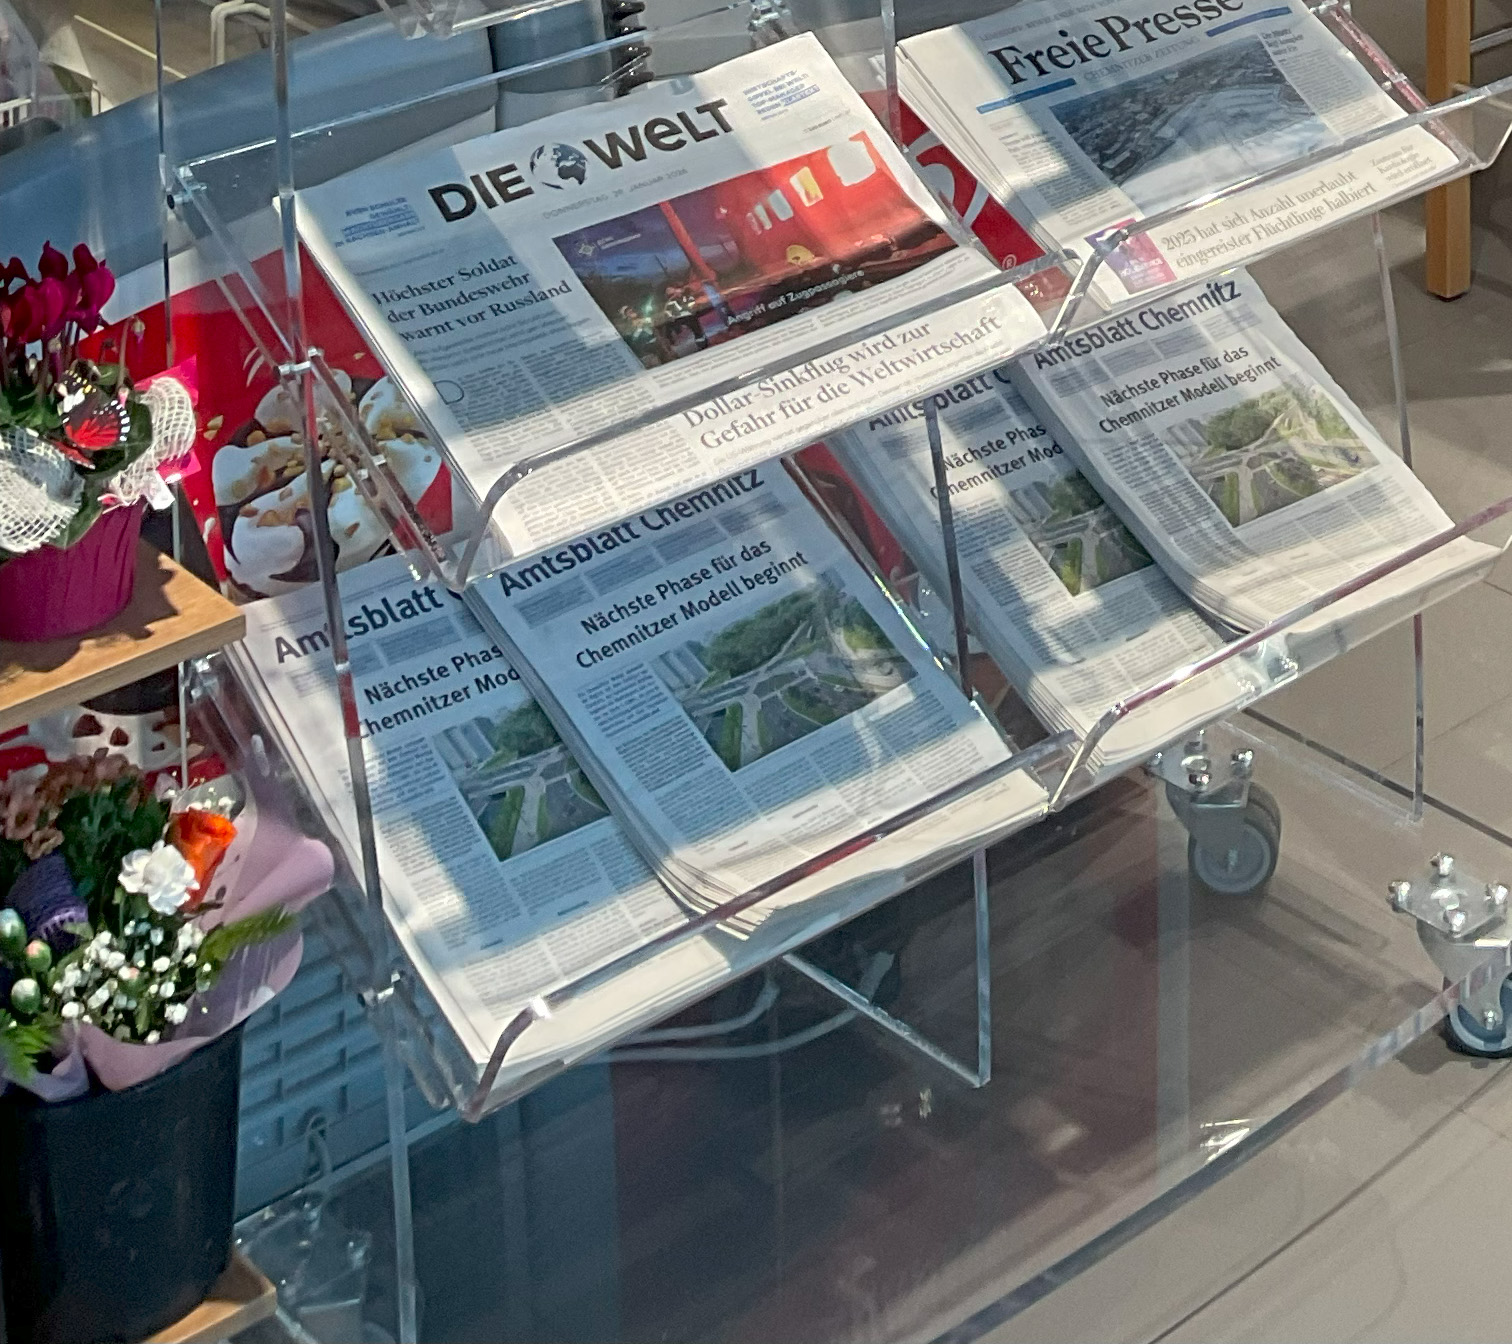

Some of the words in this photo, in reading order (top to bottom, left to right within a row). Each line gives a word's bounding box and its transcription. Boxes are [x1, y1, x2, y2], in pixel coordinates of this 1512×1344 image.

[428, 163, 535, 223] DIE
[1162, 231, 1197, 252] 2025
[1199, 222, 1219, 241] hat
[1222, 211, 1250, 233] sich
[1251, 193, 1295, 224] Anzahl
[1296, 170, 1359, 206] unerlaubt
[1176, 231, 1252, 269] eingereister
[1253, 203, 1326, 242] Flüchtlinge
[1327, 181, 1378, 213] halbiert
[371, 273, 455, 306] Höchster
[457, 254, 519, 282] Soldat
[387, 305, 419, 324] der
[421, 272, 530, 316] Bundeswehr
[399, 319, 457, 343] warnt
[457, 311, 491, 328] vor
[491, 280, 572, 317] Russland
[1034, 316, 1141, 369] Amtsblatt
[1139, 280, 1242, 331] Chemnitz
[680, 354, 845, 428] Dollar-Sinkflug
[848, 336, 897, 362] wird
[897, 321, 931, 346] zur
[700, 409, 776, 450] Gefahr
[778, 394, 815, 419] für
[816, 381, 850, 405] die
[848, 314, 1003, 389] Weltwirtschaft
[1100, 377, 1160, 408] Nächste
[1159, 360, 1201, 384] Phase
[1200, 352, 1222, 374] für
[1224, 345, 1249, 364] das
[1100, 394, 1181, 433] Chemnitzer
[1181, 376, 1228, 403] Modell
[1228, 356, 1281, 386] beginnt
[943, 437, 1007, 472] Nächste
[1006, 423, 1046, 446] Phas
[1027, 440, 1064, 464] Mod
[500, 520, 641, 597] Amtsblatt
[580, 592, 657, 635] Nächste
[656, 568, 713, 601] Phase
[711, 554, 738, 576] für
[740, 538, 772, 563] das
[576, 611, 680, 668] Chemnitzer
[679, 579, 743, 621] Modell
[741, 550, 809, 592] beginnt
[364, 665, 450, 705] Nächste
[451, 644, 504, 673] Phas
